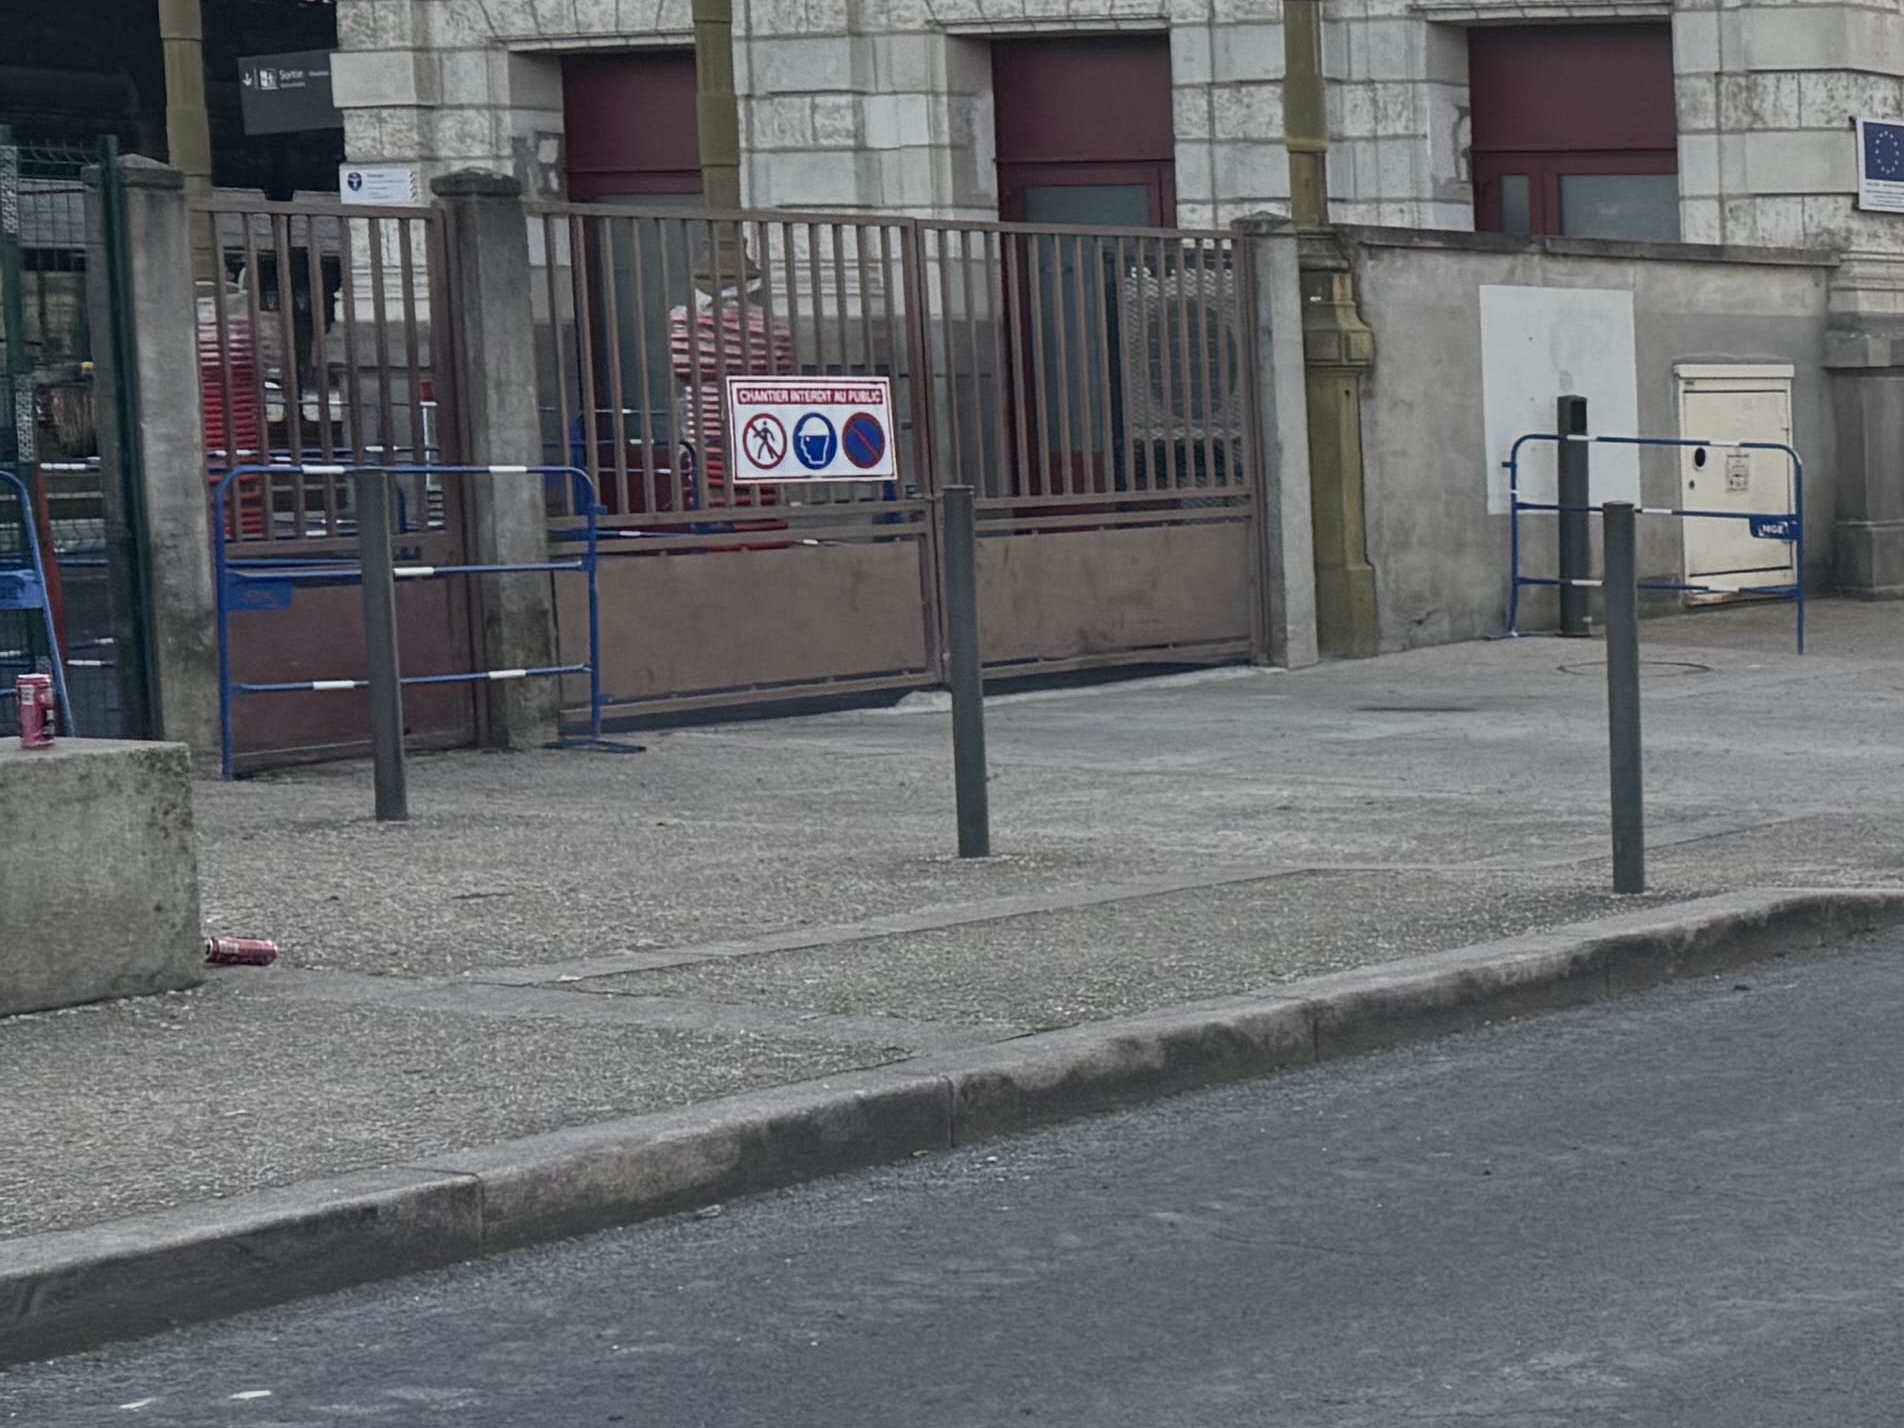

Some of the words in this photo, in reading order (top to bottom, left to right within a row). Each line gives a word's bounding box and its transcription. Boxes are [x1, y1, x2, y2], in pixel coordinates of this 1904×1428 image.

[739, 390, 789, 404] CHANTIER
[790, 390, 832, 403] INTERDIT
[833, 390, 847, 403] AU
[848, 390, 882, 403] PUBLIC
